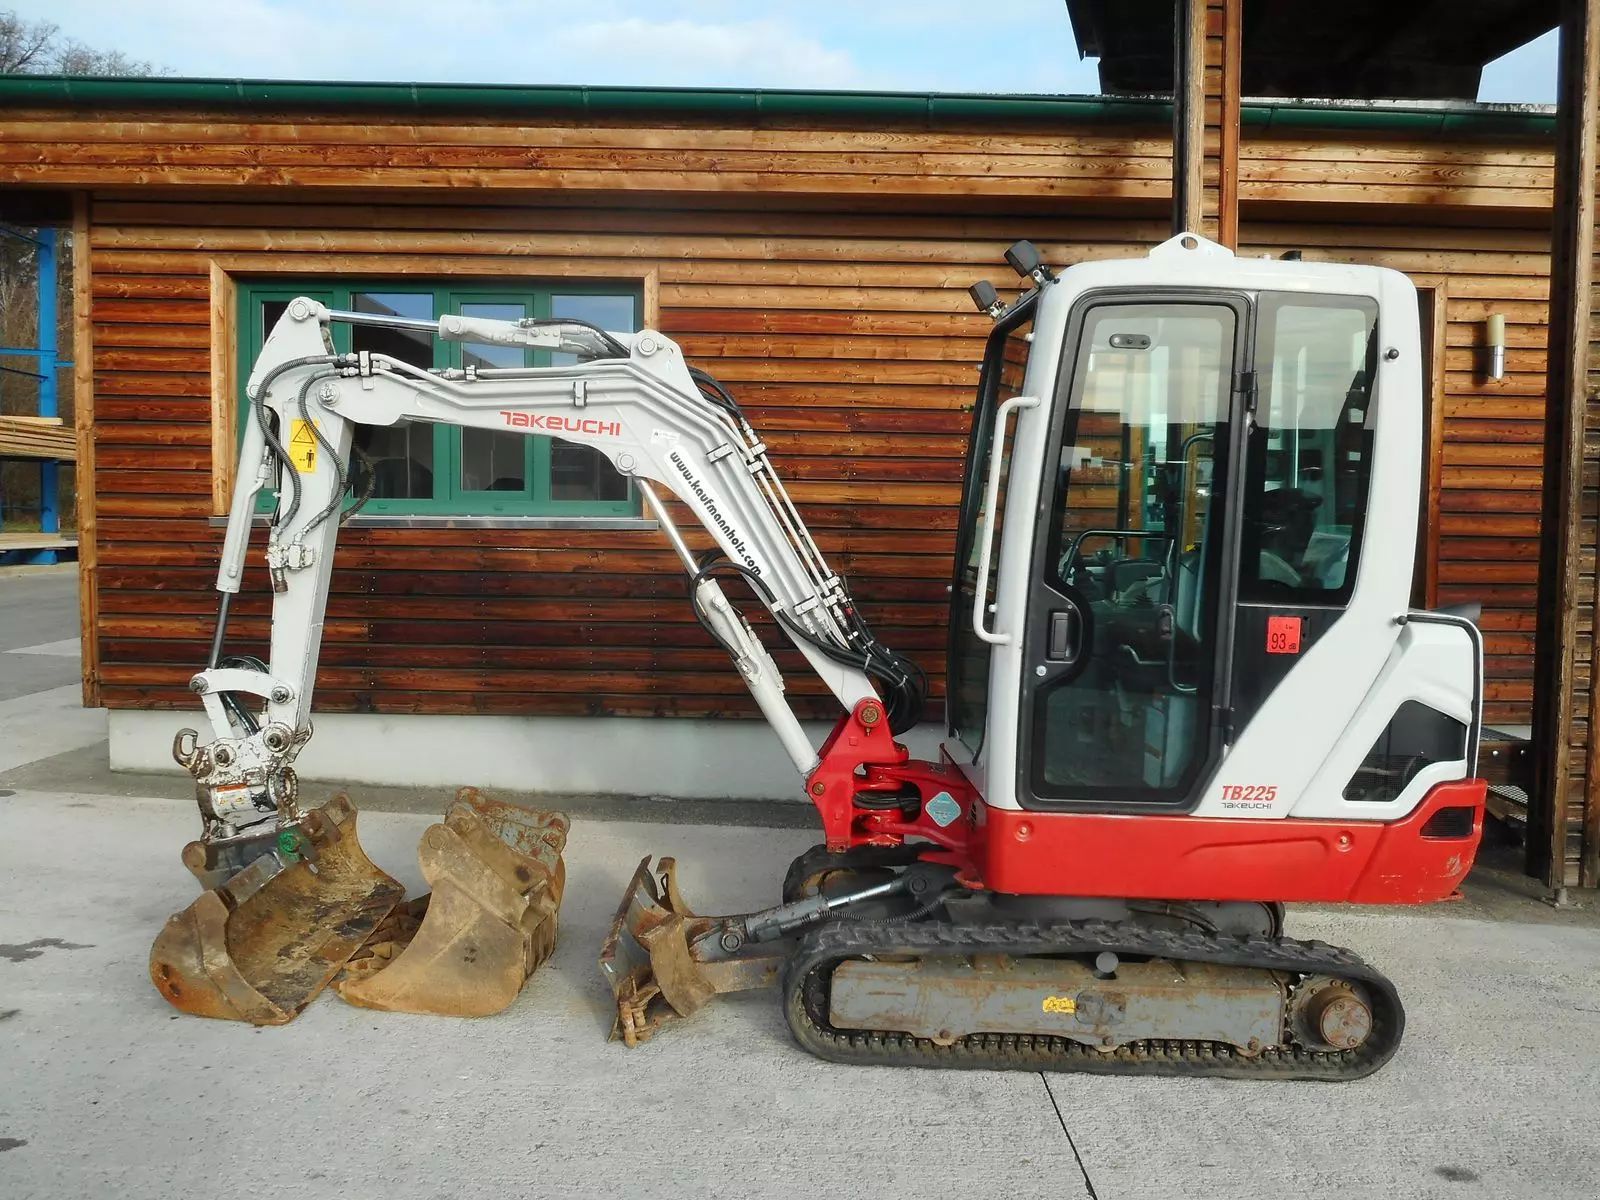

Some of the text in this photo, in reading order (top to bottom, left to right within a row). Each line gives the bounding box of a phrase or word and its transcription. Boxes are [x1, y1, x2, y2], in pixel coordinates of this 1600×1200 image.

[500, 411, 620, 436] TAKEUCHI
[670, 452, 762, 577] www.kaufmannholz.com
[1271, 632, 1286, 650] 93
[1222, 786, 1277, 801] TB225
